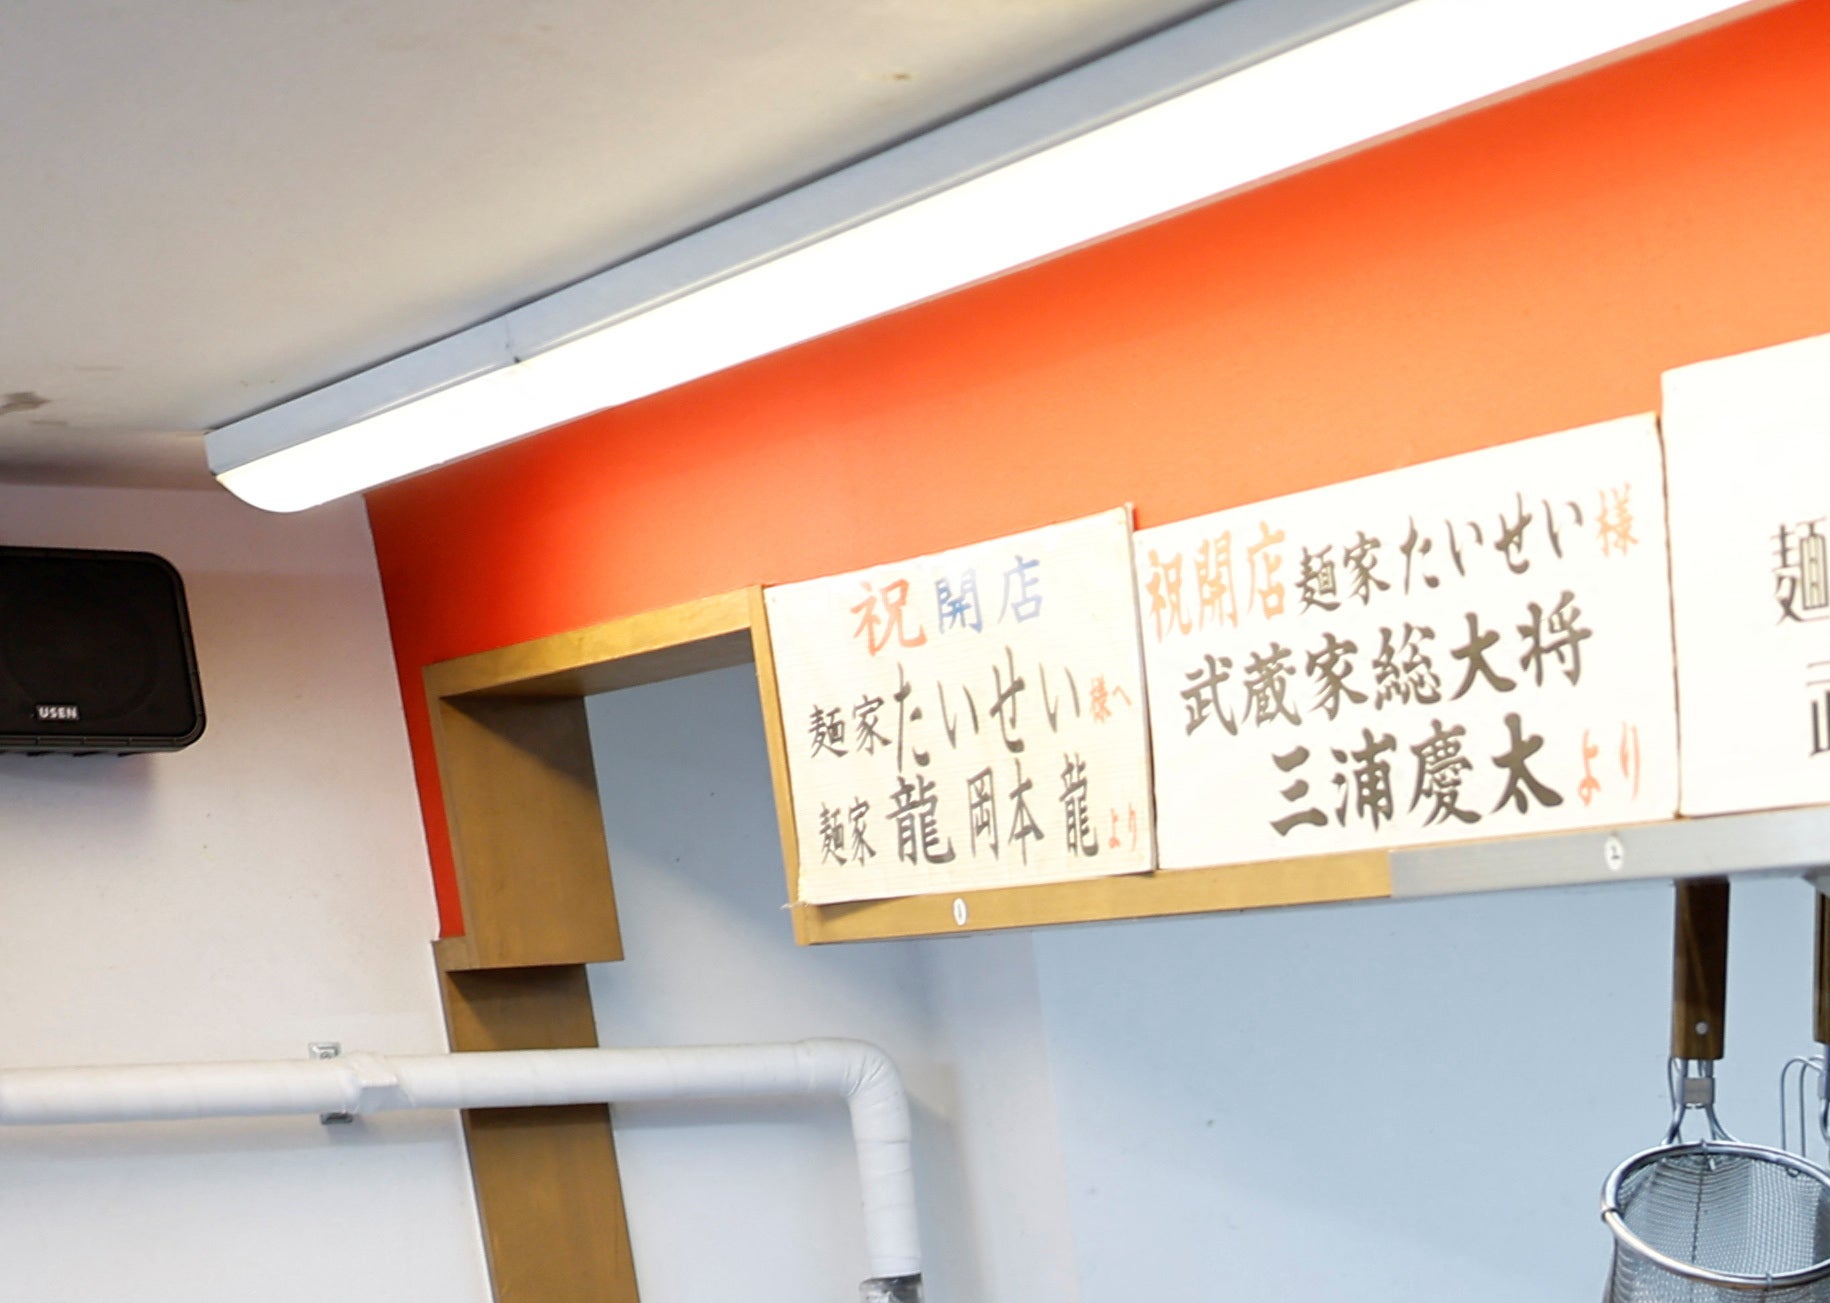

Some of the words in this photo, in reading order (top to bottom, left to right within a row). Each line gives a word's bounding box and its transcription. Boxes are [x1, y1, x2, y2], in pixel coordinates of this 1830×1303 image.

[851, 555, 1045, 658] 祝開店
[38, 705, 78, 720] USEN
[1183, 590, 1595, 739] 武蔵家総大将
